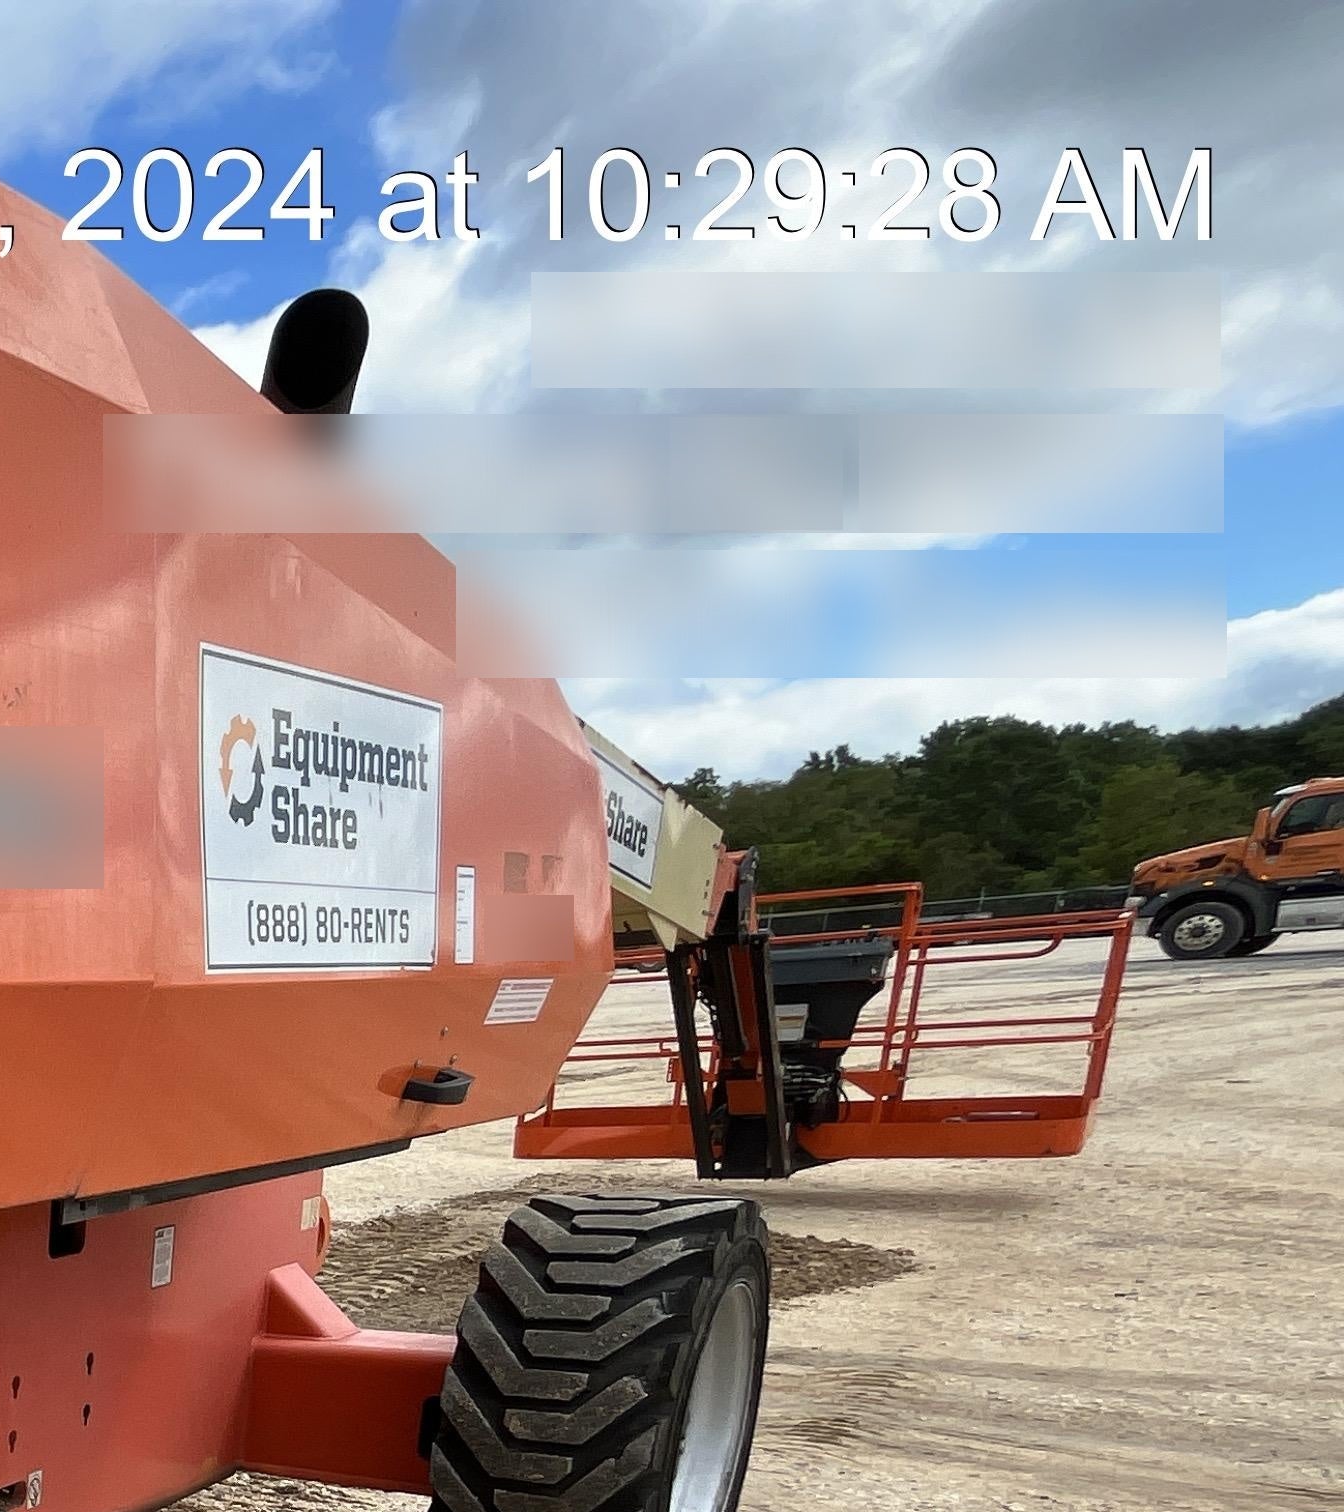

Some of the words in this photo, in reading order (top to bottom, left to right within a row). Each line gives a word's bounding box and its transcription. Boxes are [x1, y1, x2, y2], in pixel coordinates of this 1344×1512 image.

[270, 708, 429, 793] Equipment
[270, 786, 359, 850] Share
[246, 900, 307, 946] (888)
[316, 905, 410, 945] 80-RENTS
